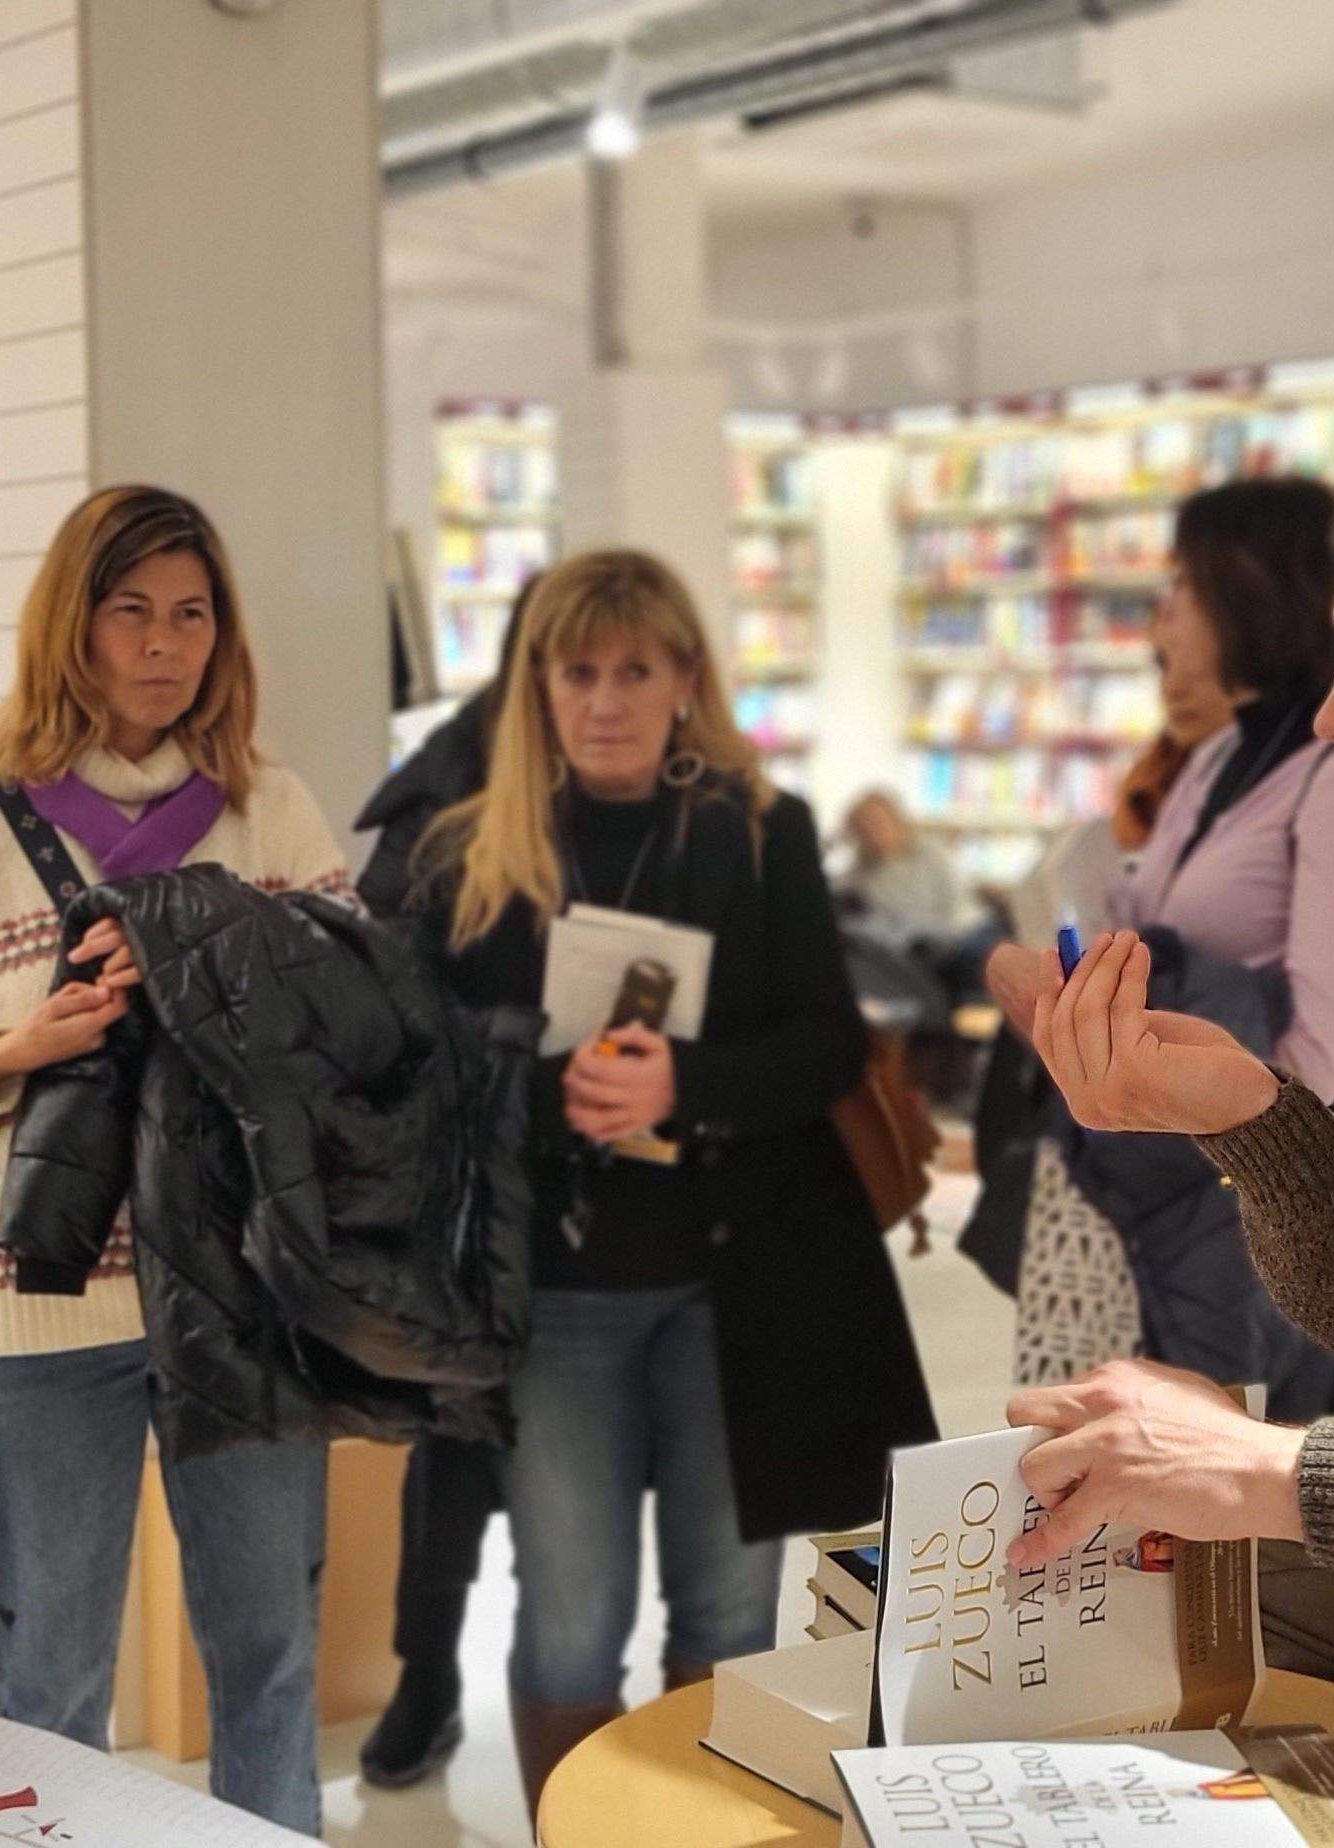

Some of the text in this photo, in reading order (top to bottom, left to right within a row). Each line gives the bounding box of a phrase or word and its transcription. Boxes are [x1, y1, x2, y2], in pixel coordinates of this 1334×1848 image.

[904, 1531, 949, 1654] LUIS
[952, 1481, 1000, 1692] ZUECO
[1055, 1567, 1071, 1595] DE
[1079, 1522, 1109, 1629] REIN
[1019, 1645, 1048, 1692] EL
[875, 1774, 951, 1833] LUIS
[932, 1754, 1028, 1848] ZUECO
[1011, 1745, 1088, 1828] TABLERO
[1108, 1761, 1179, 1827] REINA
